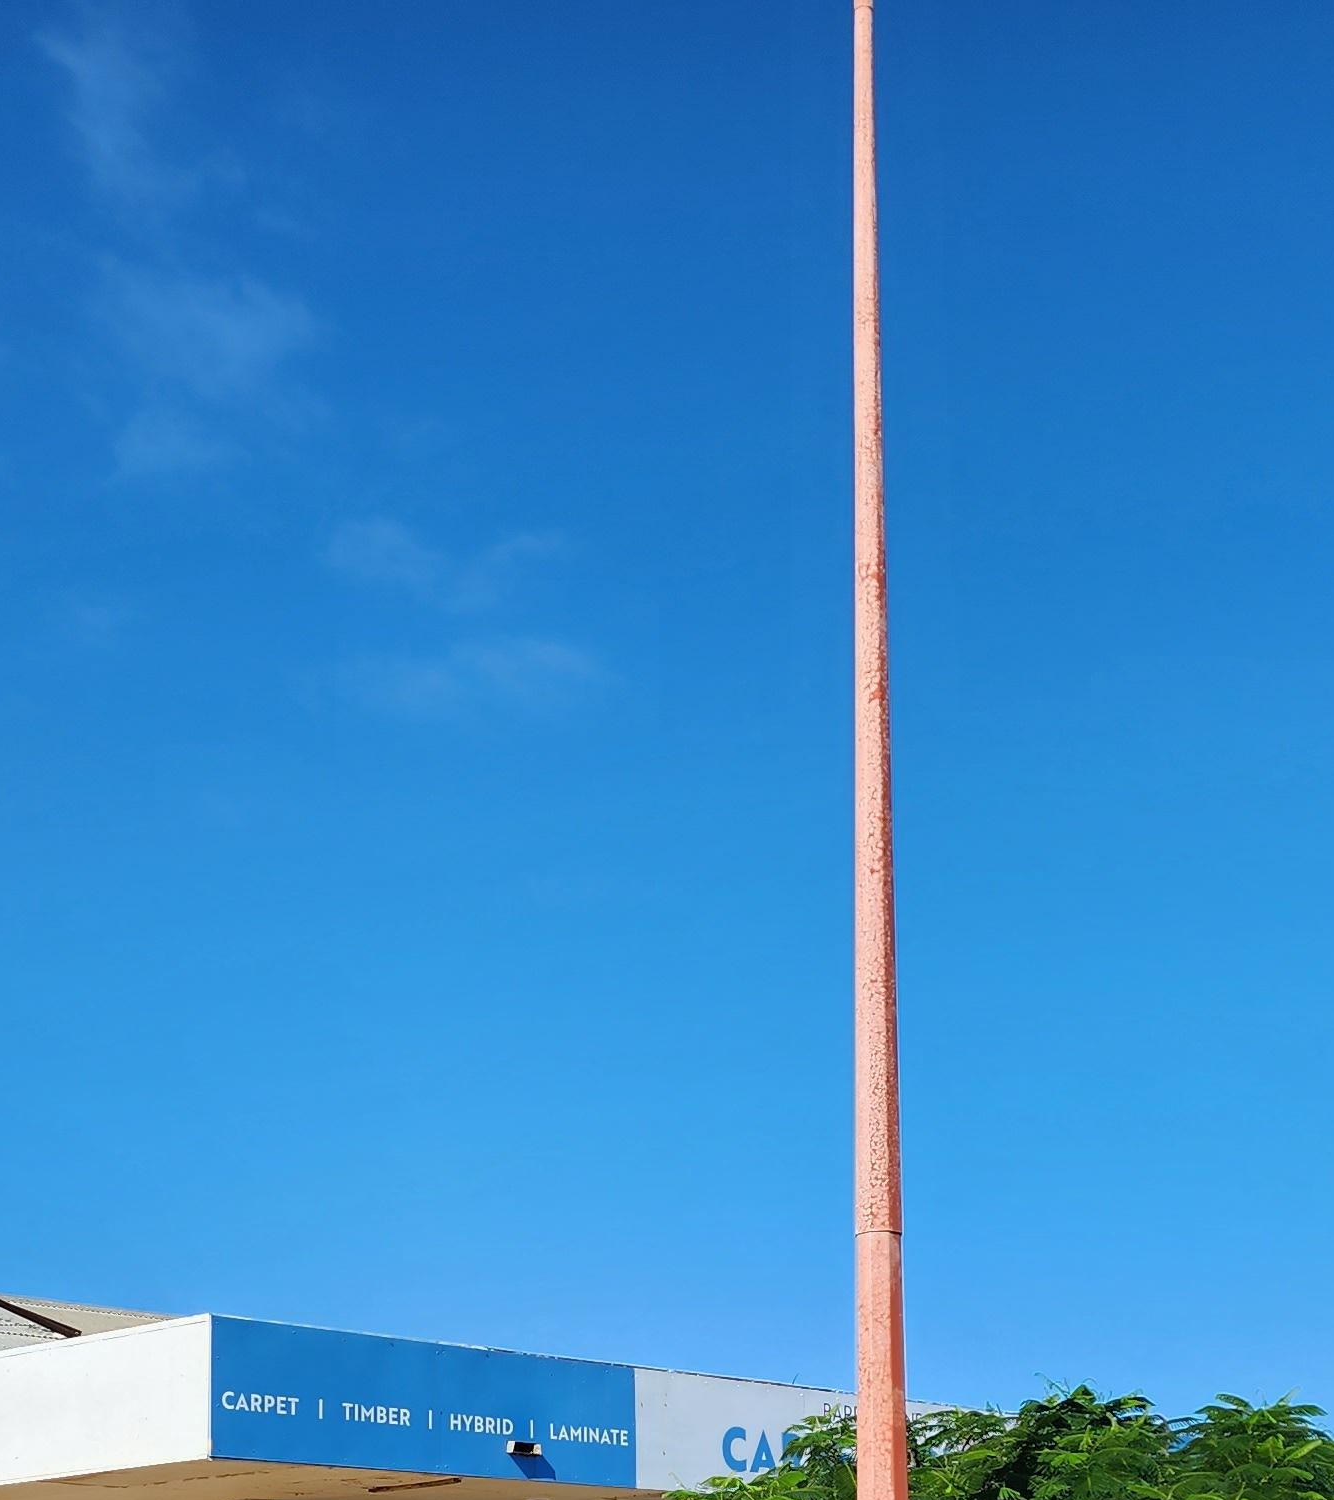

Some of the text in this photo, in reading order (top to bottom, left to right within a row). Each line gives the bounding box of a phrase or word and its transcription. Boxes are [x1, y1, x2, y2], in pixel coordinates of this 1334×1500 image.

[221, 1391, 629, 1447] CARPET TIMBER HYBRID LAMINATE
